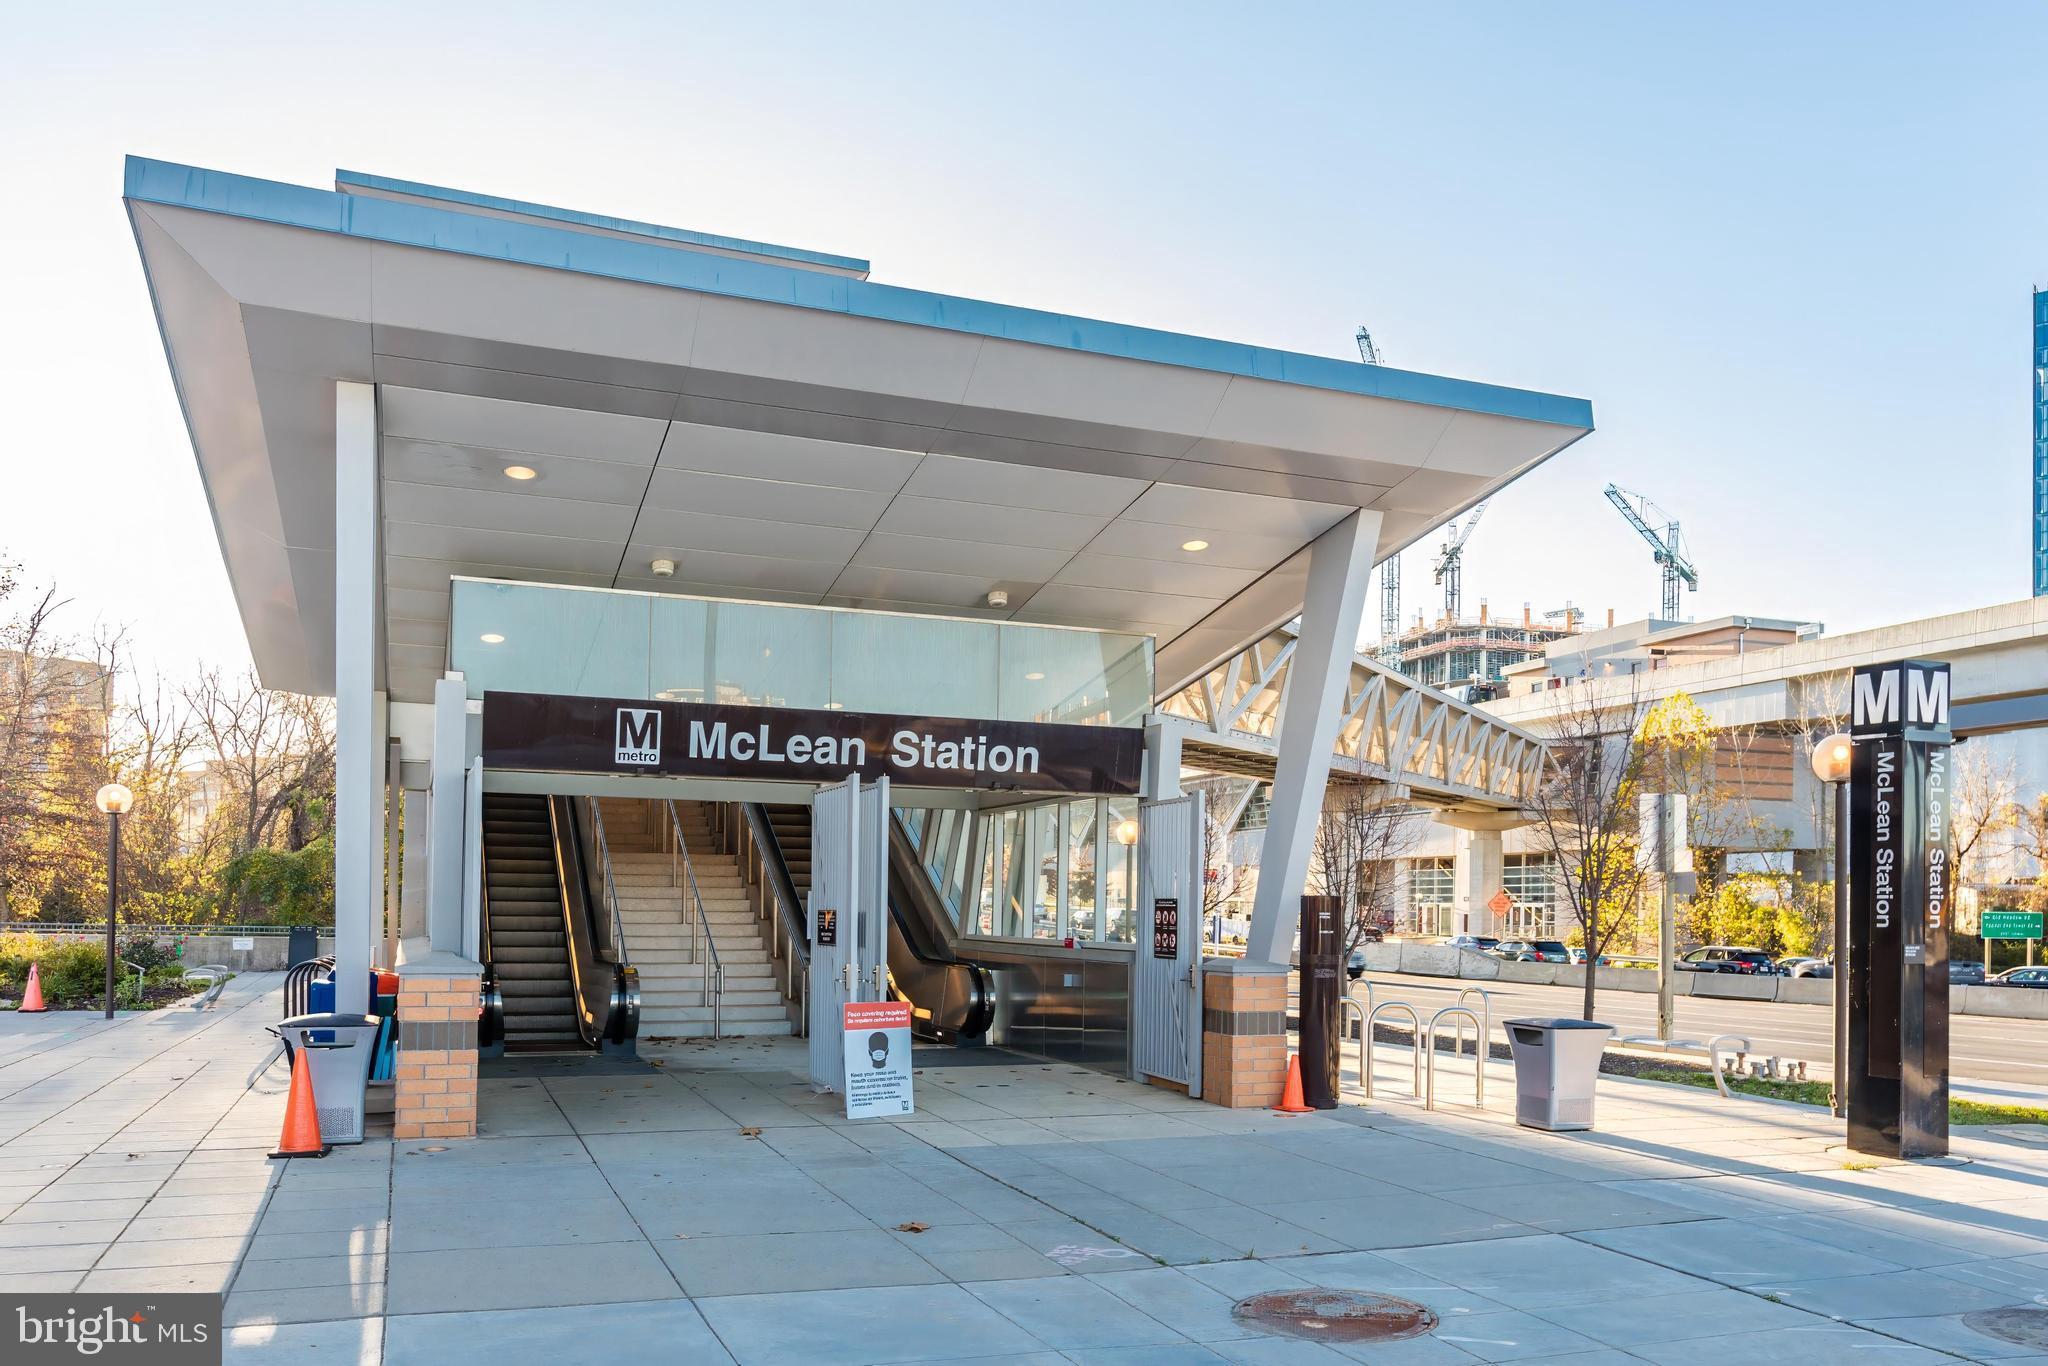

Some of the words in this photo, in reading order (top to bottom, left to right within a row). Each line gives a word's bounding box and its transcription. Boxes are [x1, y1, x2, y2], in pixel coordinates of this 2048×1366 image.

[1854, 669, 1899, 726] M
[1908, 669, 1948, 724] M
[618, 750, 657, 762] metro
[619, 711, 658, 749] M
[689, 721, 866, 766] McLean
[891, 730, 1039, 774] Station
[1877, 752, 1895, 841] McLean
[1930, 752, 1945, 841] McLean
[1876, 848, 1894, 928] Station
[1929, 849, 1944, 928] Station
